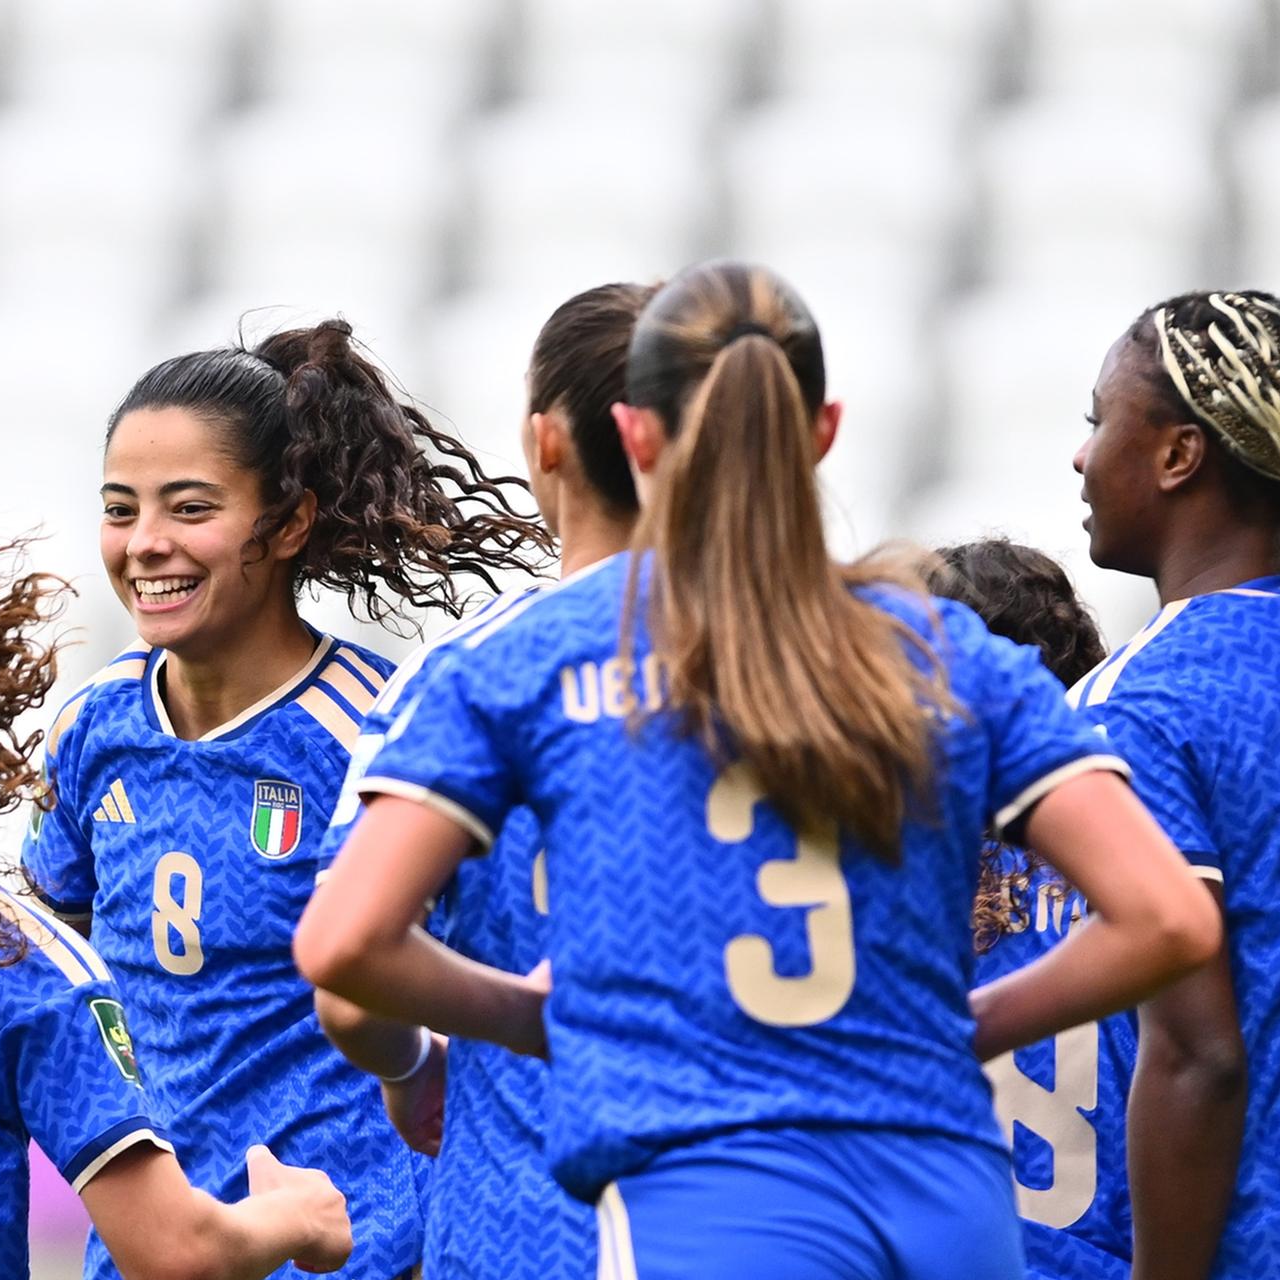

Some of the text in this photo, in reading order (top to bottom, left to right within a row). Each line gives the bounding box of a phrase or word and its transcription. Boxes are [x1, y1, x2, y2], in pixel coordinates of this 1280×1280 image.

[258, 785, 298, 803] ITALIA
[152, 851, 205, 976] 8
[706, 761, 856, 1028] 3
